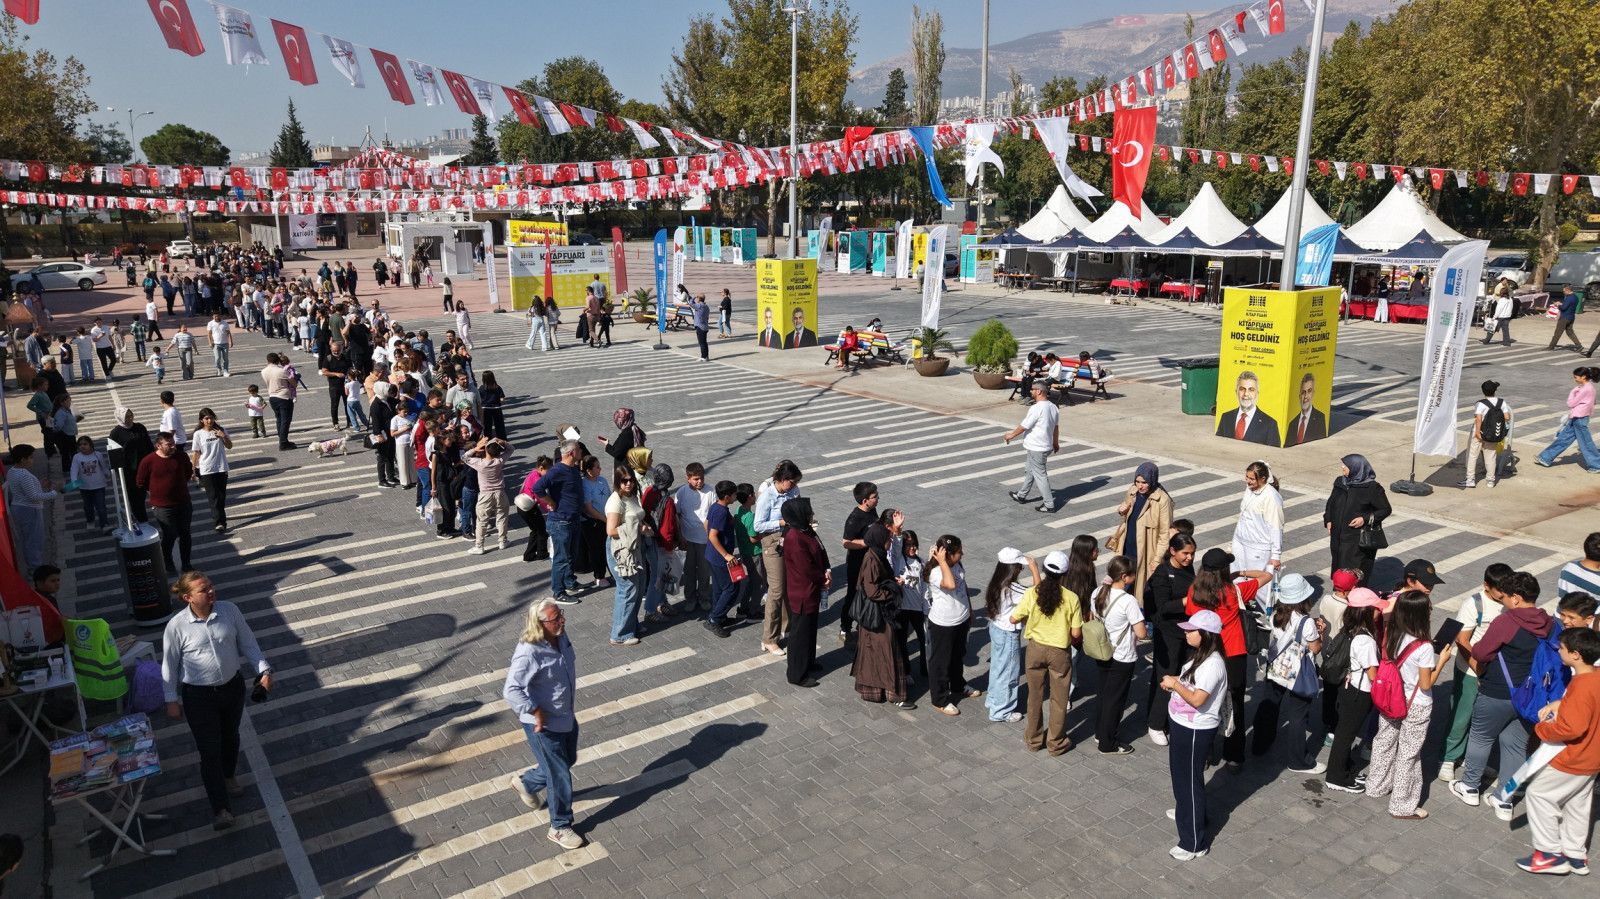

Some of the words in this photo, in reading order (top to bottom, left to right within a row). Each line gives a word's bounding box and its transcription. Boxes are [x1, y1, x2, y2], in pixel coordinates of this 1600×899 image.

[540, 252, 562, 260] KTAP
[1454, 268, 1463, 296] unesco
[1256, 321, 1273, 329] FUARI
[1231, 332, 1245, 342] HOŞ
[1247, 332, 1280, 343] GELDİNİZ
[1298, 335, 1308, 345] HOŞ
[1309, 331, 1330, 342] GELDİNİZ
[1435, 346, 1451, 408] Kahramanmaraş
